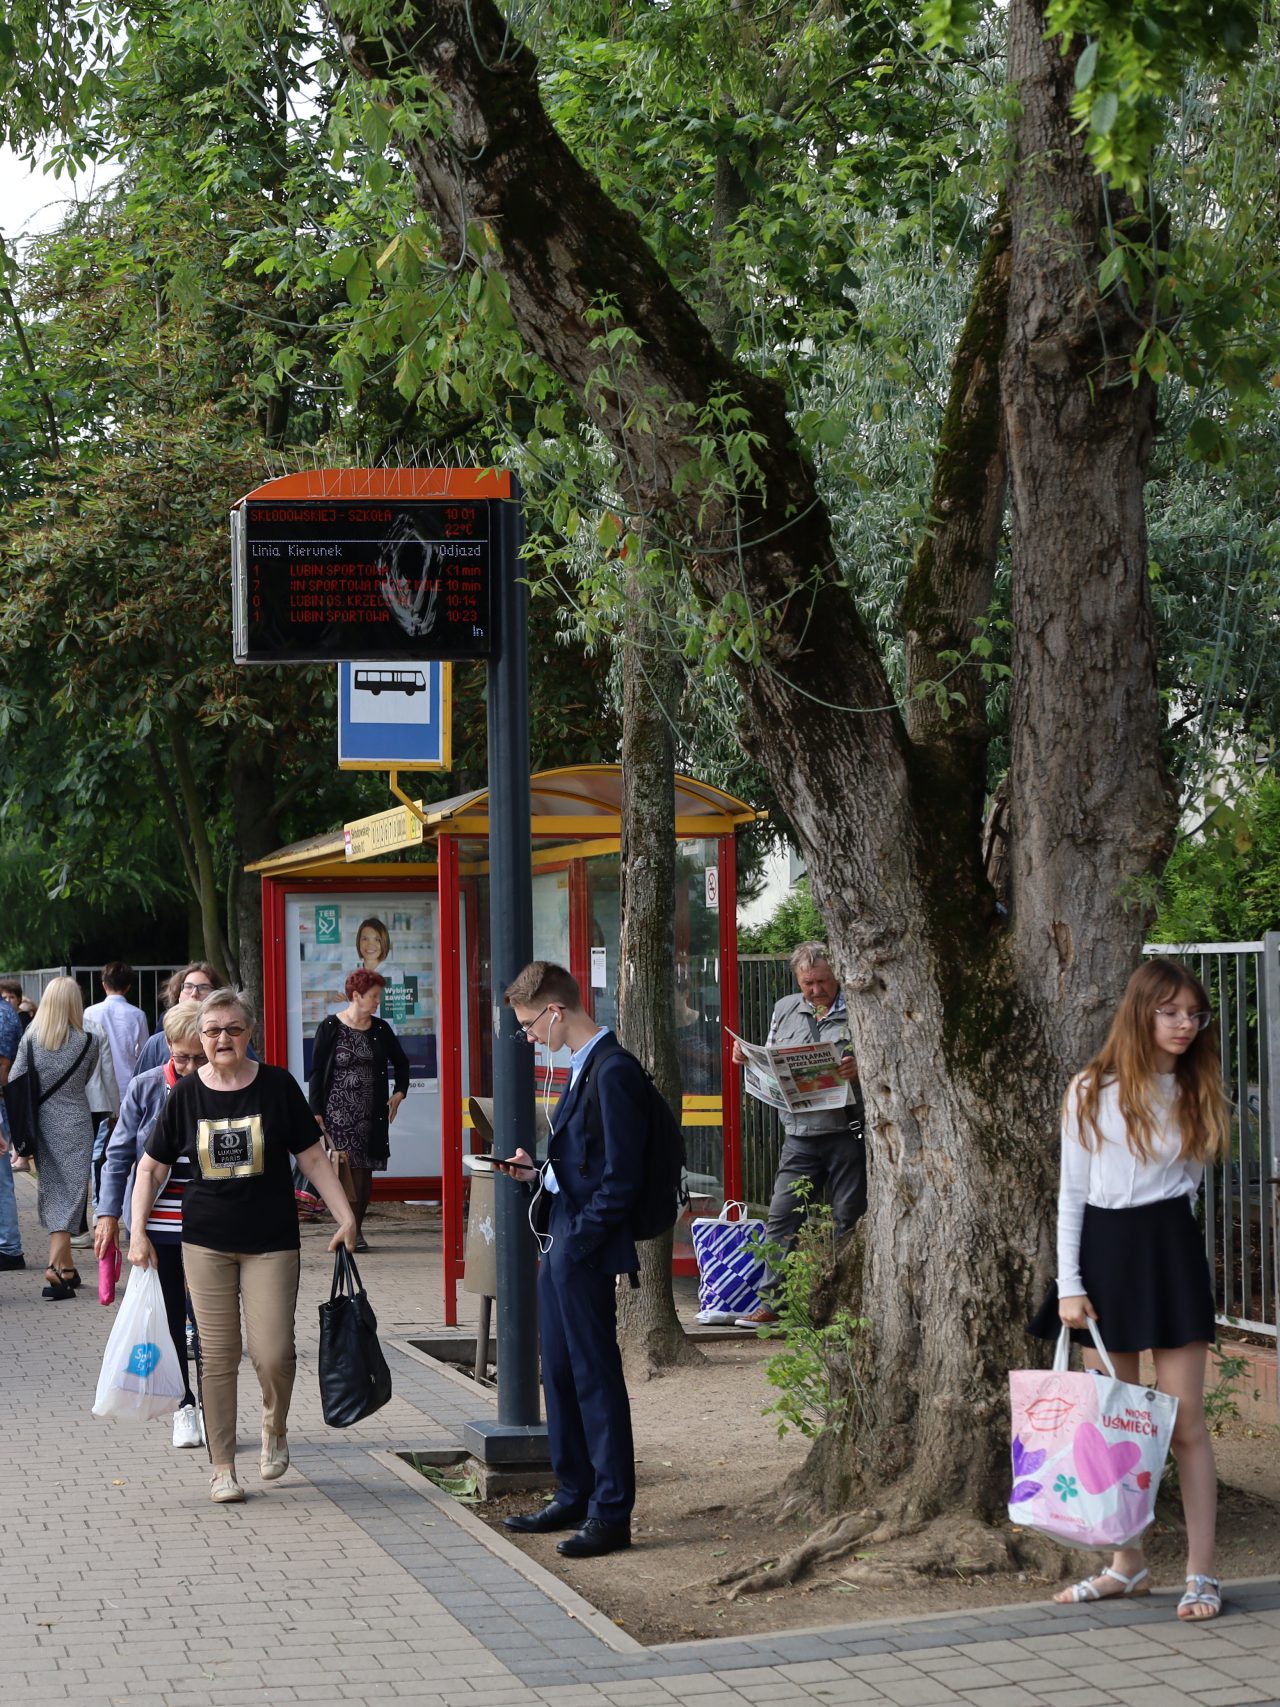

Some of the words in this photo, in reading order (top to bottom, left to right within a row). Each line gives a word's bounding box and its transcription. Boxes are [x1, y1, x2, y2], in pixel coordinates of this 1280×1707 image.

[252, 544, 280, 557] Linia
[288, 544, 343, 557] Kierunek
[439, 544, 481, 557] Odjazd
[290, 564, 323, 577] LUBIN
[462, 566, 481, 576] min
[308, 580, 371, 592] SPORTOWA
[447, 580, 459, 592] 10
[462, 582, 481, 592] min
[290, 595, 323, 607] LUBIN
[290, 610, 324, 622] LUBIN
[326, 610, 390, 622] SPORTOWA
[786, 1051, 832, 1062] PRZYŁAPANI
[809, 1057, 836, 1065] kamery
[1102, 1413, 1158, 1437] UŚMIECH
